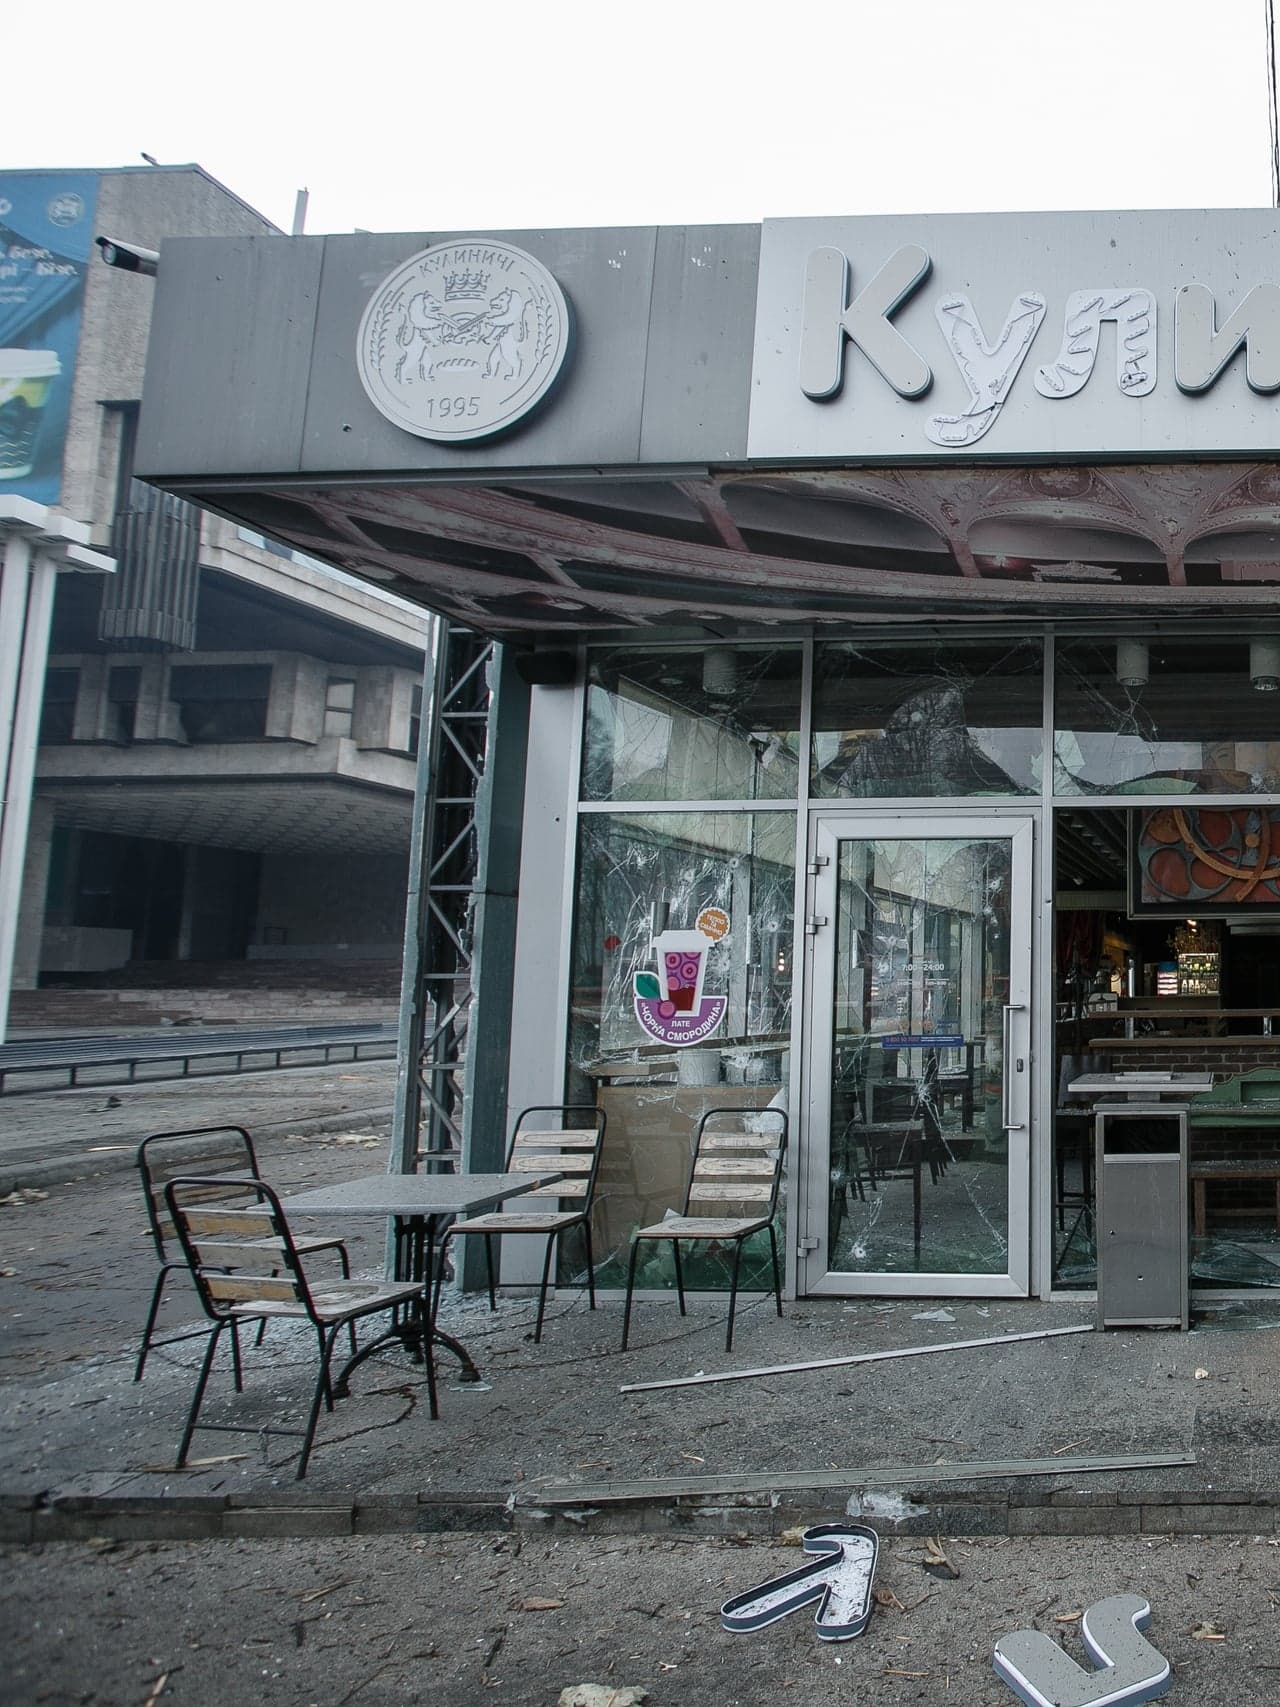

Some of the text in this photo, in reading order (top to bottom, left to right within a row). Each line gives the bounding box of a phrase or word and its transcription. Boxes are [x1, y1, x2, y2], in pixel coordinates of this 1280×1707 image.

[419, 249, 516, 278] КУЛИНИЧІ
[427, 396, 481, 418] 1995
[666, 1001, 721, 1041] СМОРОДИНА»
[671, 1020, 691, 1028] ЛАТЕ
